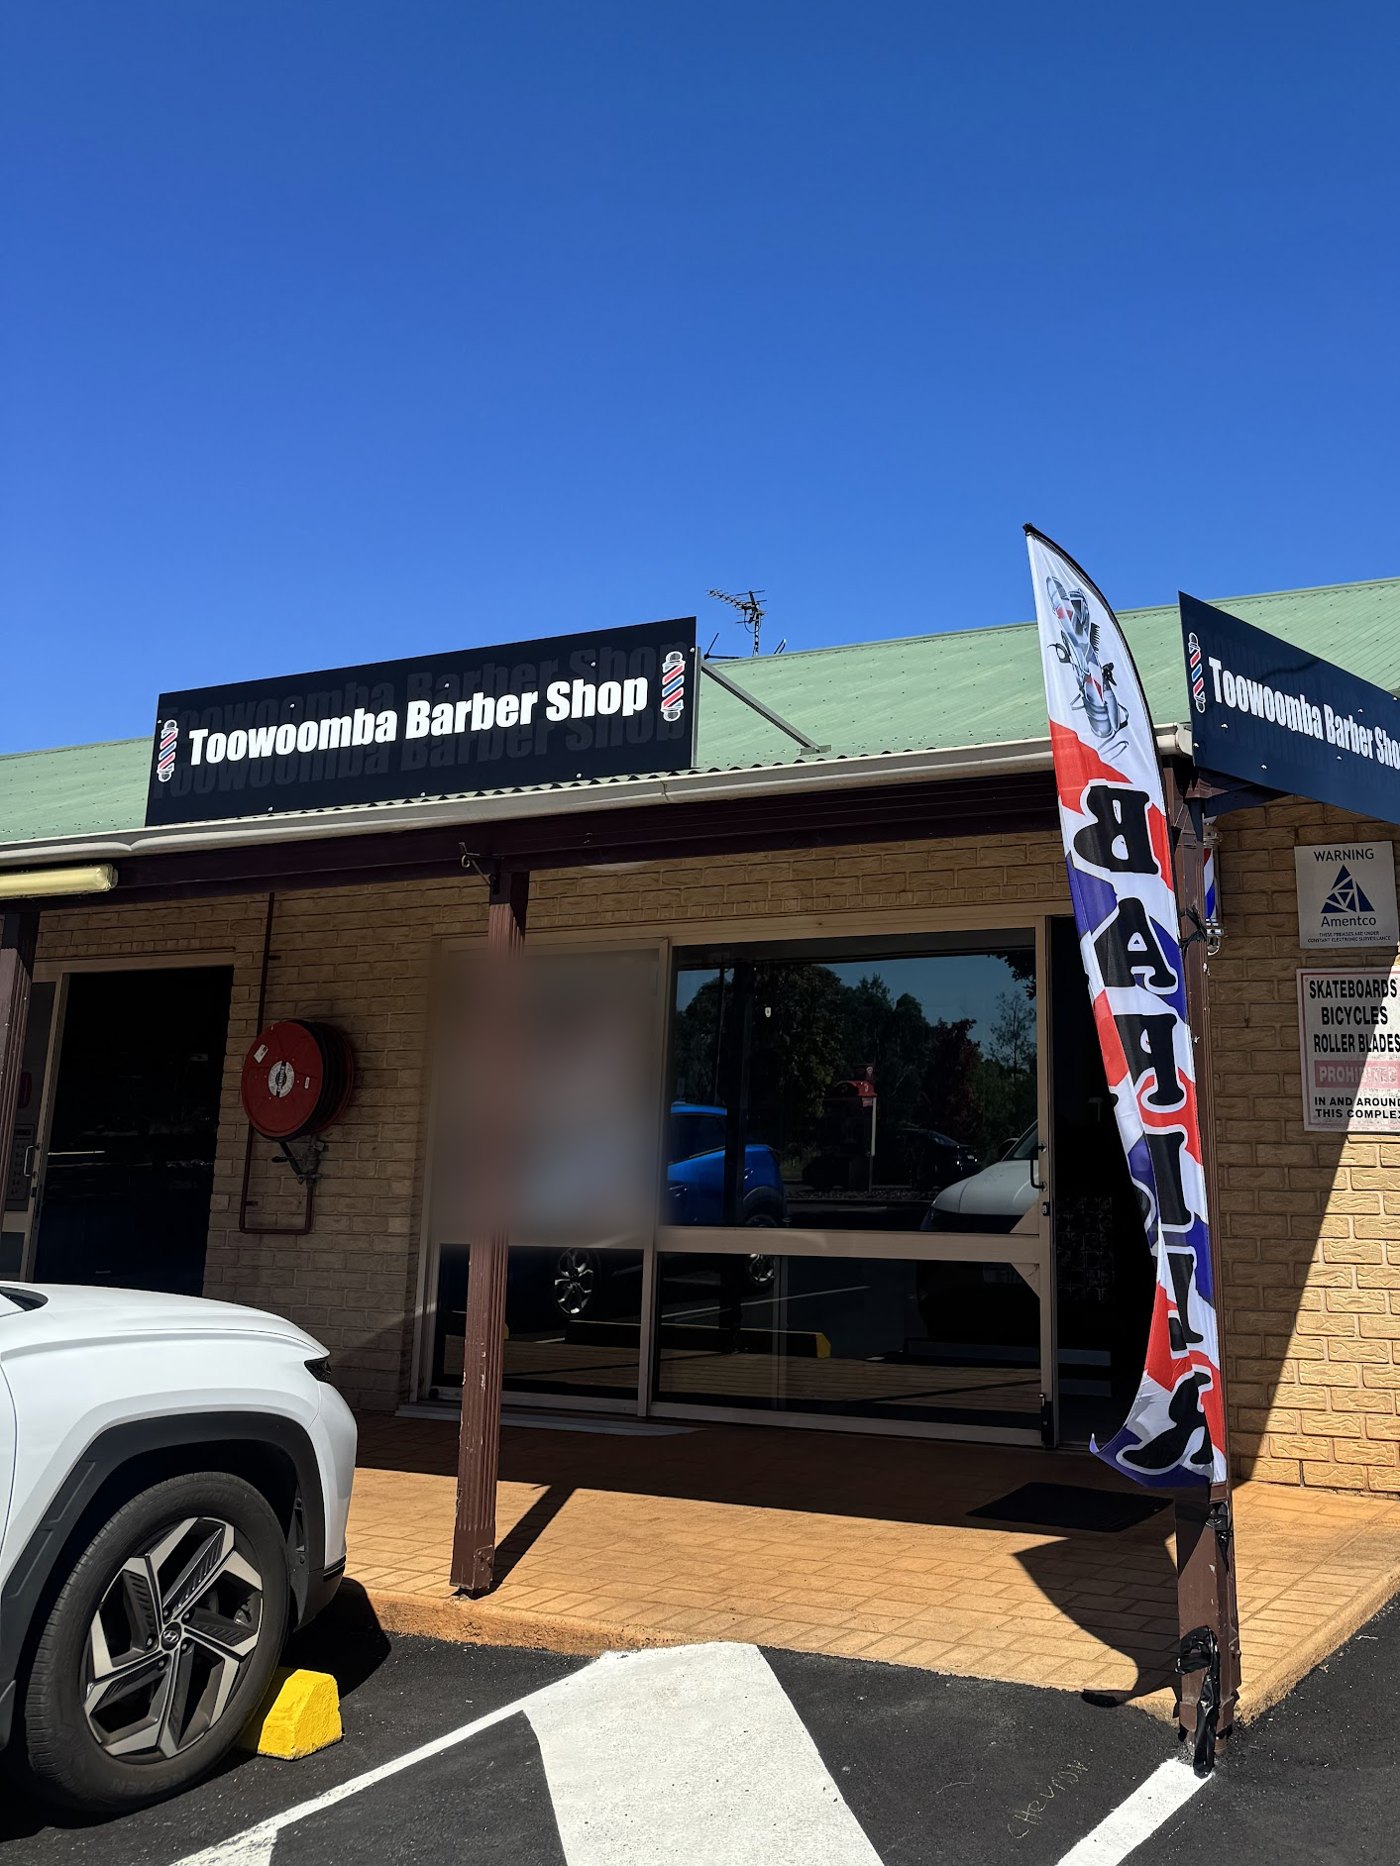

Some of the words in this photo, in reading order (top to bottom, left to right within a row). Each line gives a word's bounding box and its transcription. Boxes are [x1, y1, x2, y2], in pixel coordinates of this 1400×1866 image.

[189, 707, 398, 766] Toowoomba
[405, 688, 539, 740] Barber
[546, 675, 649, 720] Shop
[1208, 656, 1324, 740] Toowoomba
[1324, 703, 1373, 760] Barber
[1374, 726, 1400, 770] Sho
[1313, 848, 1374, 862] WARNING
[1321, 916, 1376, 927] Amentco
[1309, 979, 1398, 999] SKATEBOARDS
[1321, 1006, 1388, 1026] BICYCLES
[1313, 1034, 1355, 1053] ROLLER
[1358, 1033, 1400, 1053] BLADES
[1314, 1096, 1327, 1106] IN
[1329, 1097, 1353, 1106] AND
[1315, 1108, 1343, 1118] THIS
